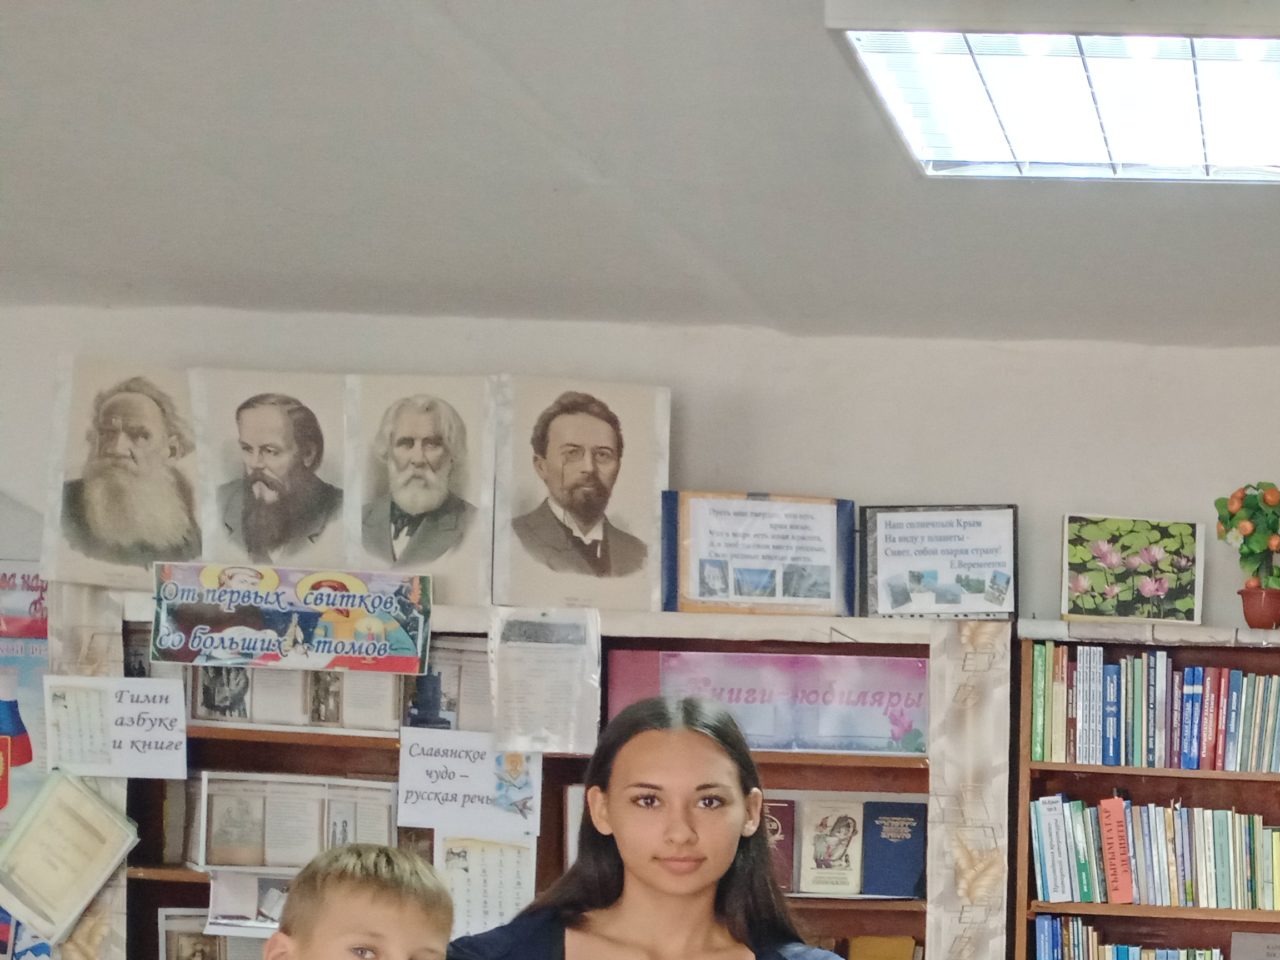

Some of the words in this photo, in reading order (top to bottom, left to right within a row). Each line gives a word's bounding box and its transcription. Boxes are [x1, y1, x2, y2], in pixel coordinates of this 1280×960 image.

[160, 581, 197, 602] От
[203, 589, 289, 612] первых
[303, 590, 399, 613] свитков,
[190, 626, 289, 657] больших
[313, 638, 390, 656] томов
[115, 690, 170, 705] Гимн
[115, 712, 178, 732] азбуке
[112, 740, 122, 750] и
[130, 740, 183, 753] книге
[409, 743, 486, 762] Славянское
[425, 766, 455, 783] чудо
[404, 789, 458, 804] русская
